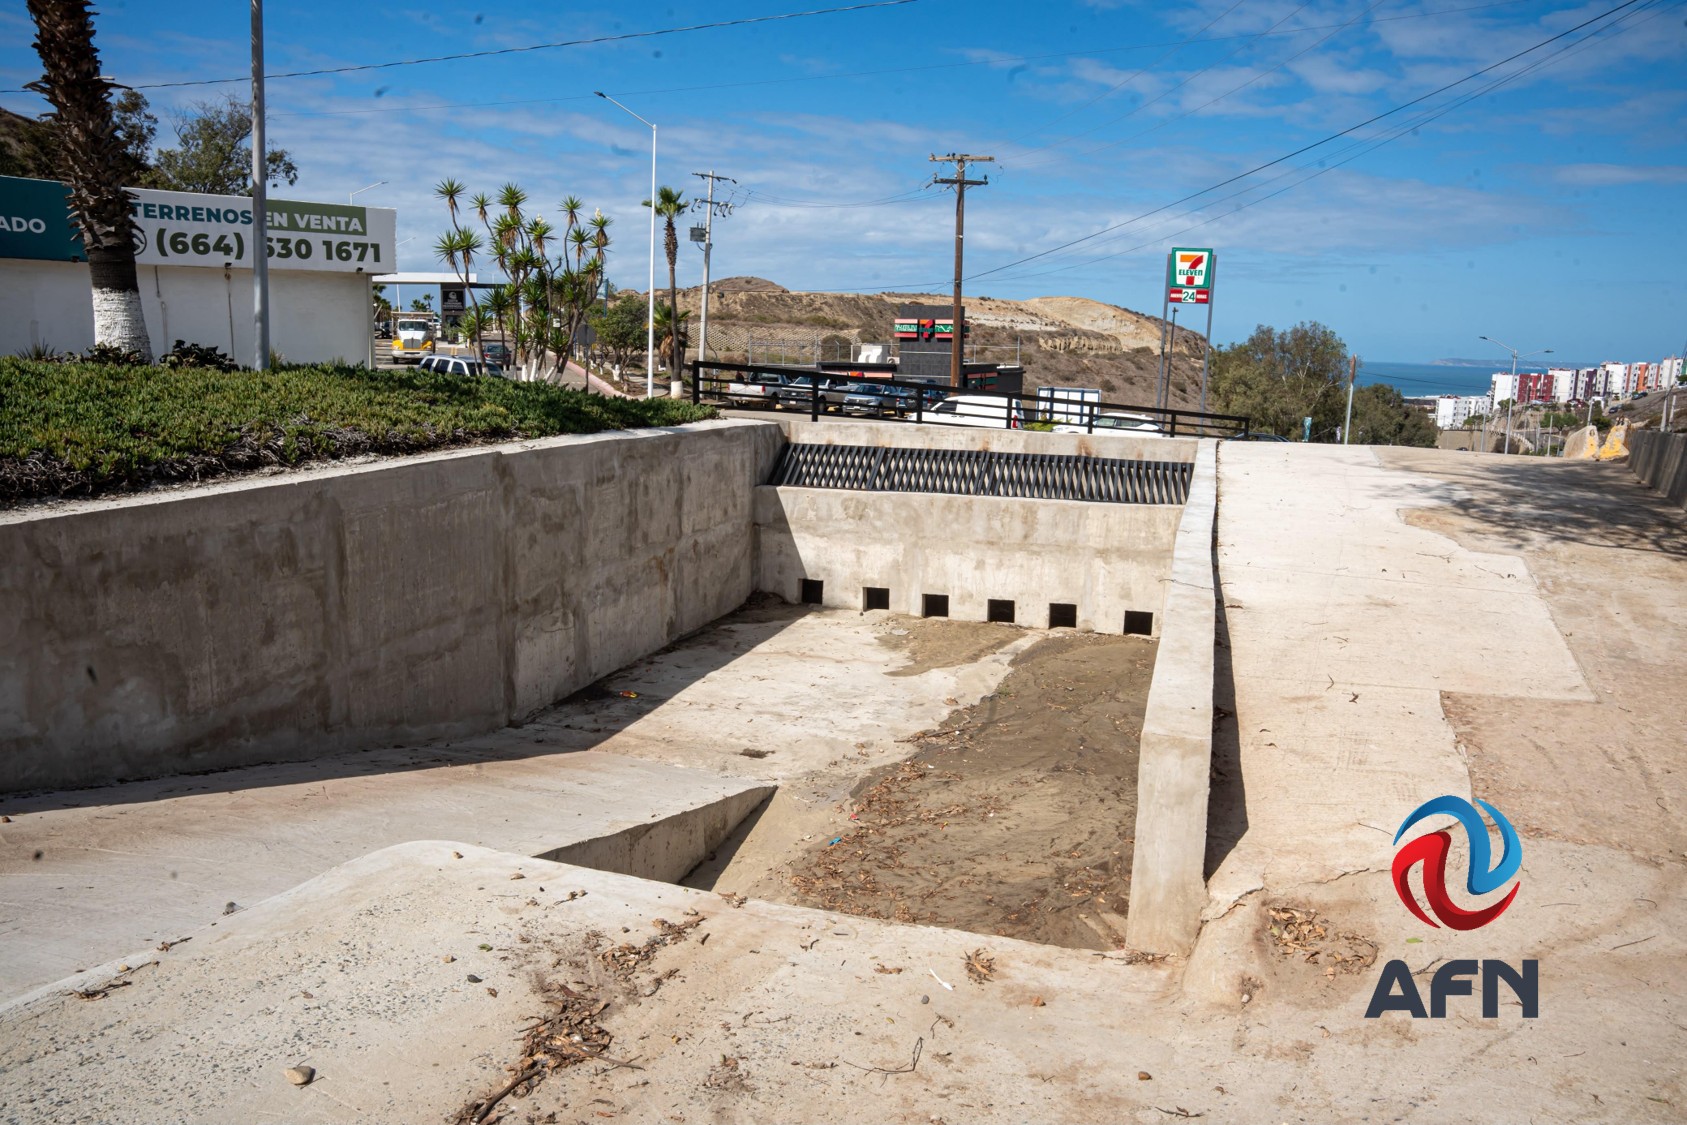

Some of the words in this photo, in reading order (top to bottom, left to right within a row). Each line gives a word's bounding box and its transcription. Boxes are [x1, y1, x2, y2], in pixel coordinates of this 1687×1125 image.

[294, 213, 363, 232] VENTA
[157, 228, 244, 260] (664)
[322, 240, 381, 263] 1671
[1180, 255, 1203, 285] 7
[1182, 291, 1195, 301] 24
